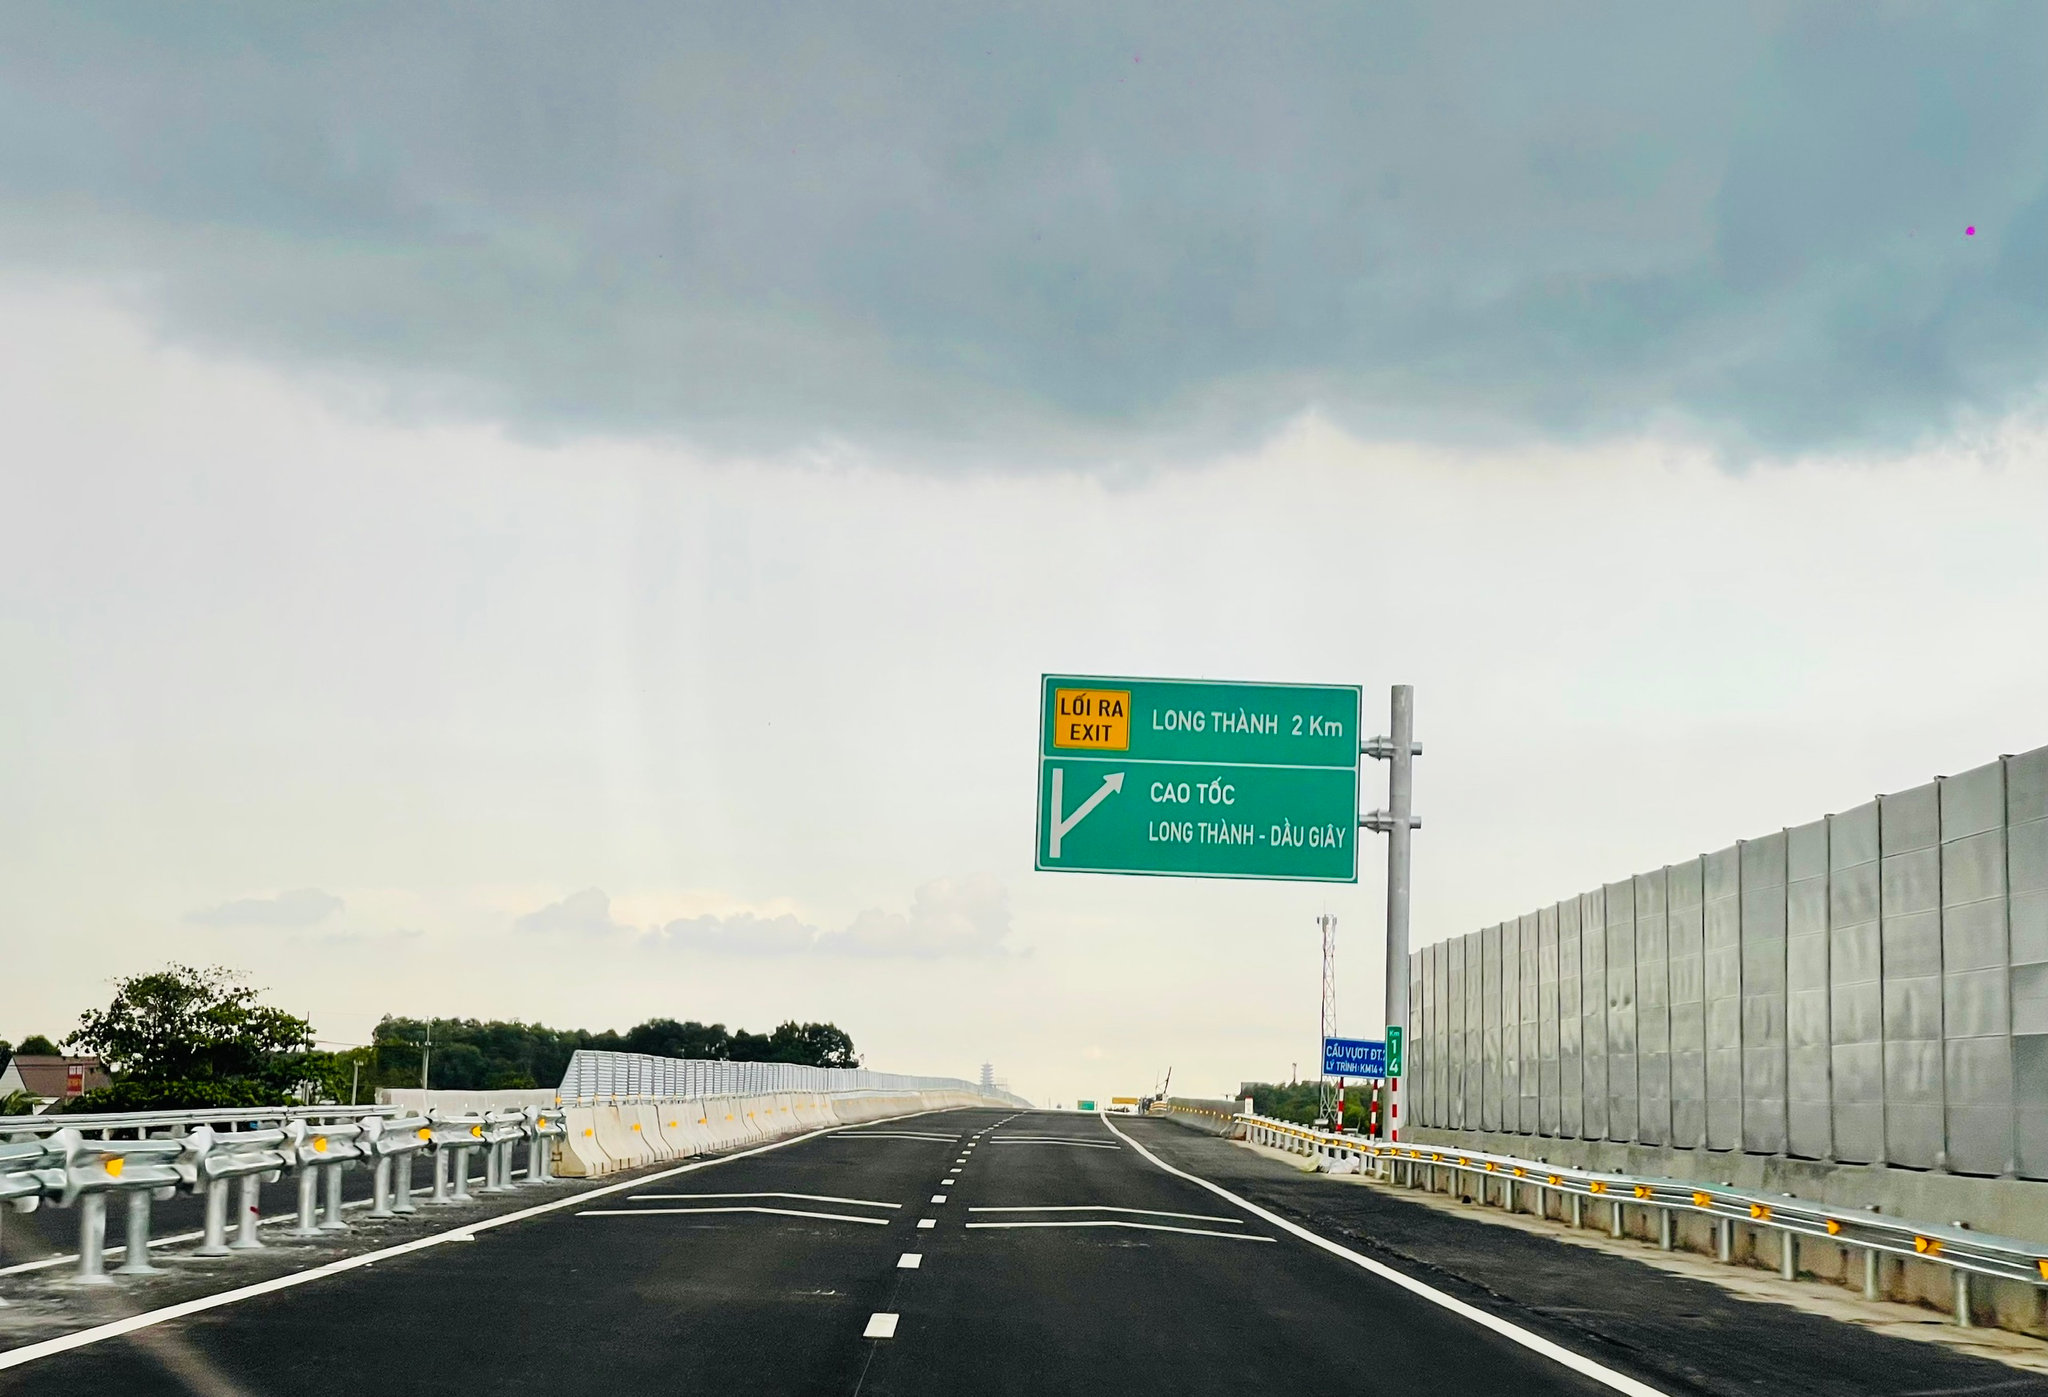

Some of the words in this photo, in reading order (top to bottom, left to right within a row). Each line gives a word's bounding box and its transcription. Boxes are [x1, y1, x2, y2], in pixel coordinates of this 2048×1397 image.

[1061, 693, 1090, 716] LỐI
[1099, 699, 1123, 718] RA
[1070, 724, 1113, 742] EXIT
[1152, 709, 1205, 733] LONG
[1211, 710, 1278, 735] THÀNH
[1292, 716, 1302, 736] 2
[1310, 715, 1343, 737] Km
[1151, 782, 1190, 804] CAO
[1196, 776, 1235, 805] TỐC
[1149, 821, 1193, 843] LONG
[1198, 818, 1254, 845] THÀNH
[1270, 817, 1304, 848] DẦU
[1309, 822, 1346, 849] GIÂY
